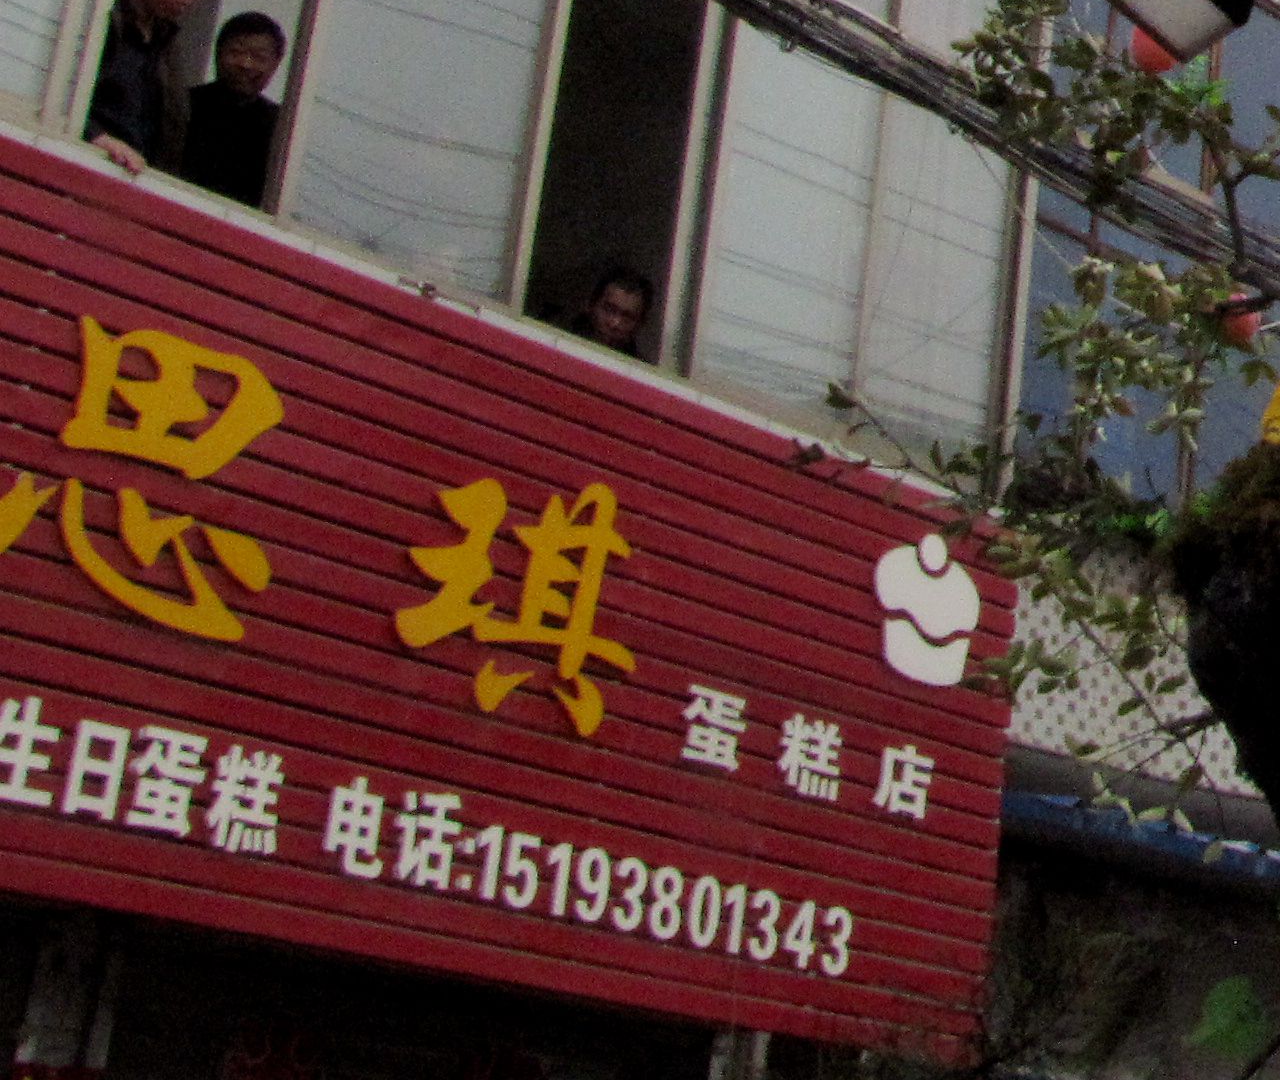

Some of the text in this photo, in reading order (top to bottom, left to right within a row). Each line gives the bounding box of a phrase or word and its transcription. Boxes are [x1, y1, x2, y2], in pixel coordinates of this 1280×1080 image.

[0, 695, 284, 855] 生日蛋糕
[681, 683, 936, 821] 蛋糕店
